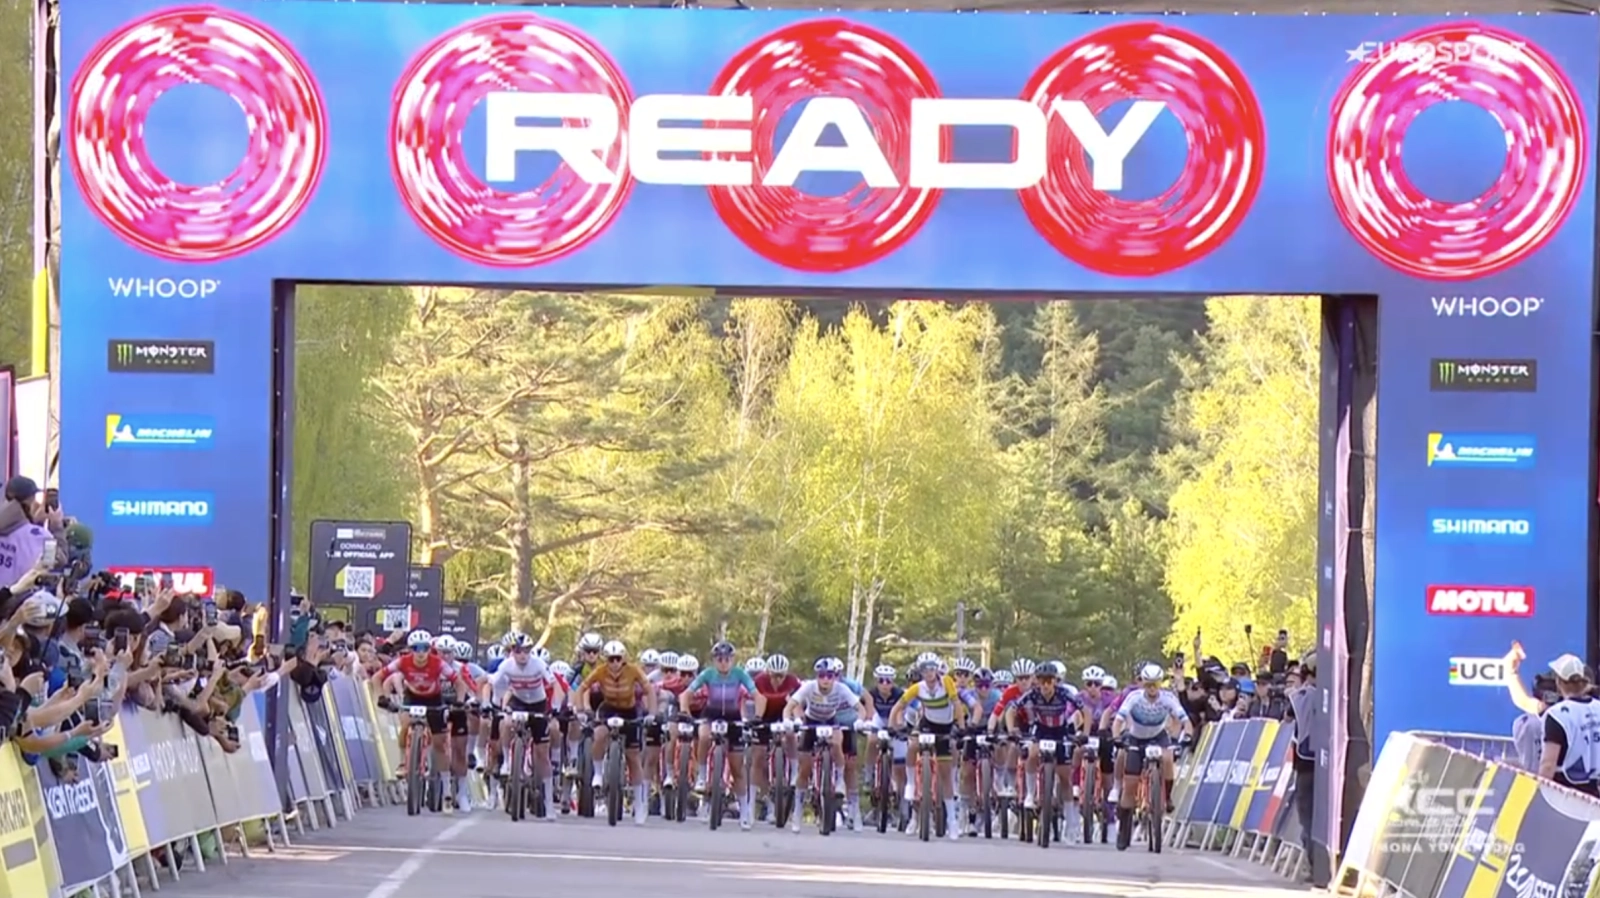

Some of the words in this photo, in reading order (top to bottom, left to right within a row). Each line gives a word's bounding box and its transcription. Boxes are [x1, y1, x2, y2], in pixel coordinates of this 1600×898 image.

[485, 91, 1167, 191] READY
[135, 344, 207, 358] MONSTER
[1457, 363, 1529, 376] MONSTER
[111, 500, 208, 516] SHIMANO
[1432, 518, 1530, 534] SHIMANO
[340, 542, 382, 550] DOWNLOAD
[343, 551, 377, 559] OFFICIAL
[112, 572, 209, 594] MUL
[1431, 590, 1529, 612] MOTUL
[1460, 663, 1504, 680] UCI
